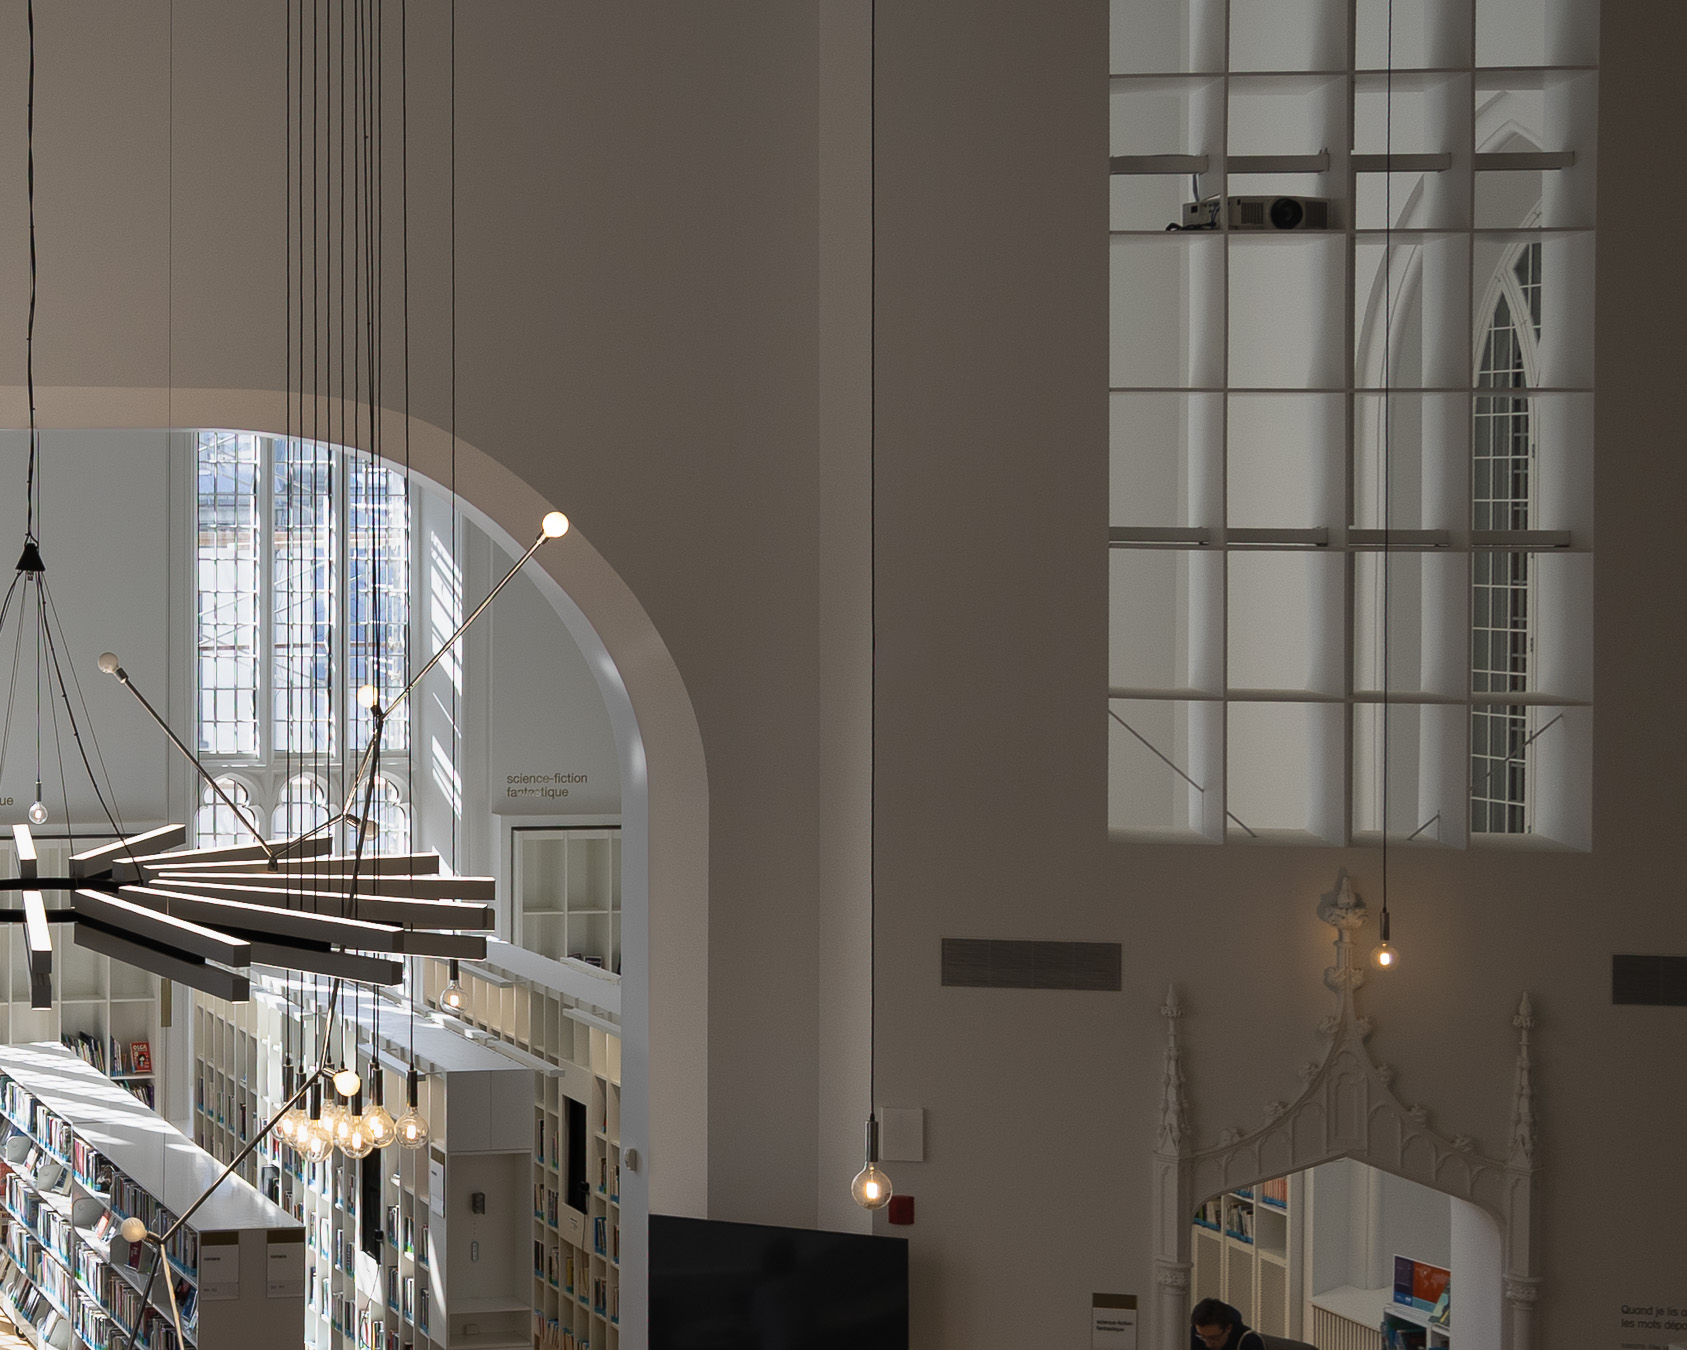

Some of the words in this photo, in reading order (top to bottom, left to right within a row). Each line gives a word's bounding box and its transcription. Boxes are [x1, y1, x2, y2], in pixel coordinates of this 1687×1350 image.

[506, 772, 588, 784] science-fiction
[1620, 1304, 1654, 1316] Quand
[1655, 1306, 1665, 1318] je
[1667, 1306, 1679, 1316] lis
[1620, 1318, 1635, 1328] les
[1638, 1320, 1662, 1330] mots
